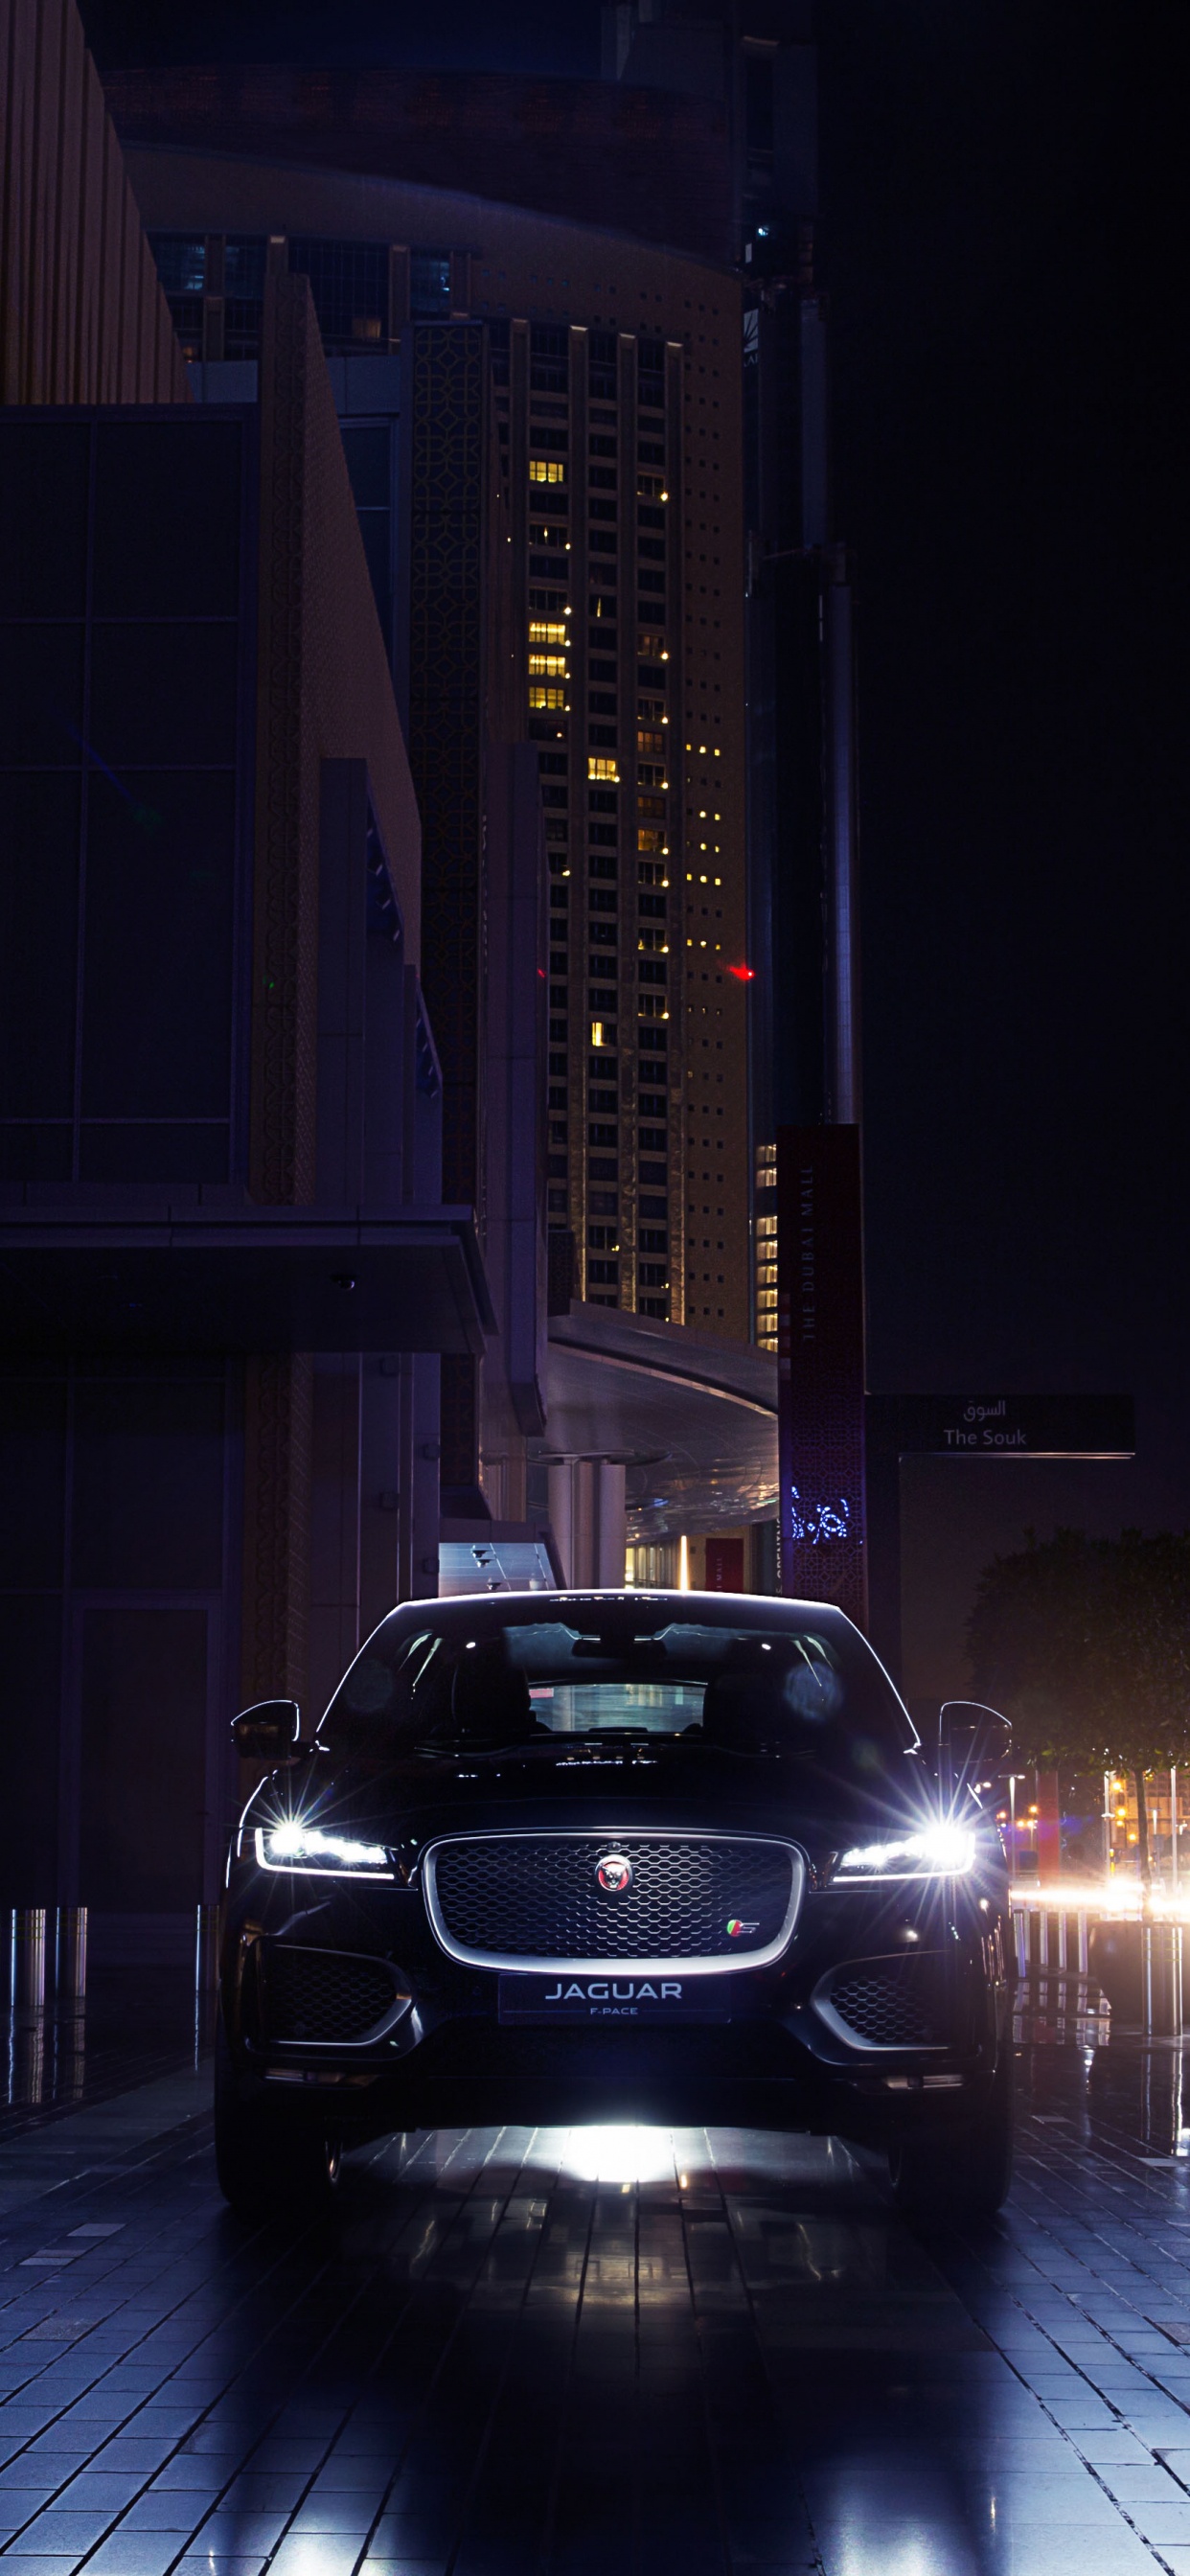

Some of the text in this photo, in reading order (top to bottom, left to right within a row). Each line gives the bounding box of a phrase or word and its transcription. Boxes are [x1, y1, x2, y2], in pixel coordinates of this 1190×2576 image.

[799, 1165, 815, 1341] THE DUBAI MALL
[963, 1399, 1007, 1423] السوق
[943, 1429, 1028, 1446] The Souk
[544, 1982, 683, 2001] JAGUAR
[590, 2007, 639, 2016] F-PACE
